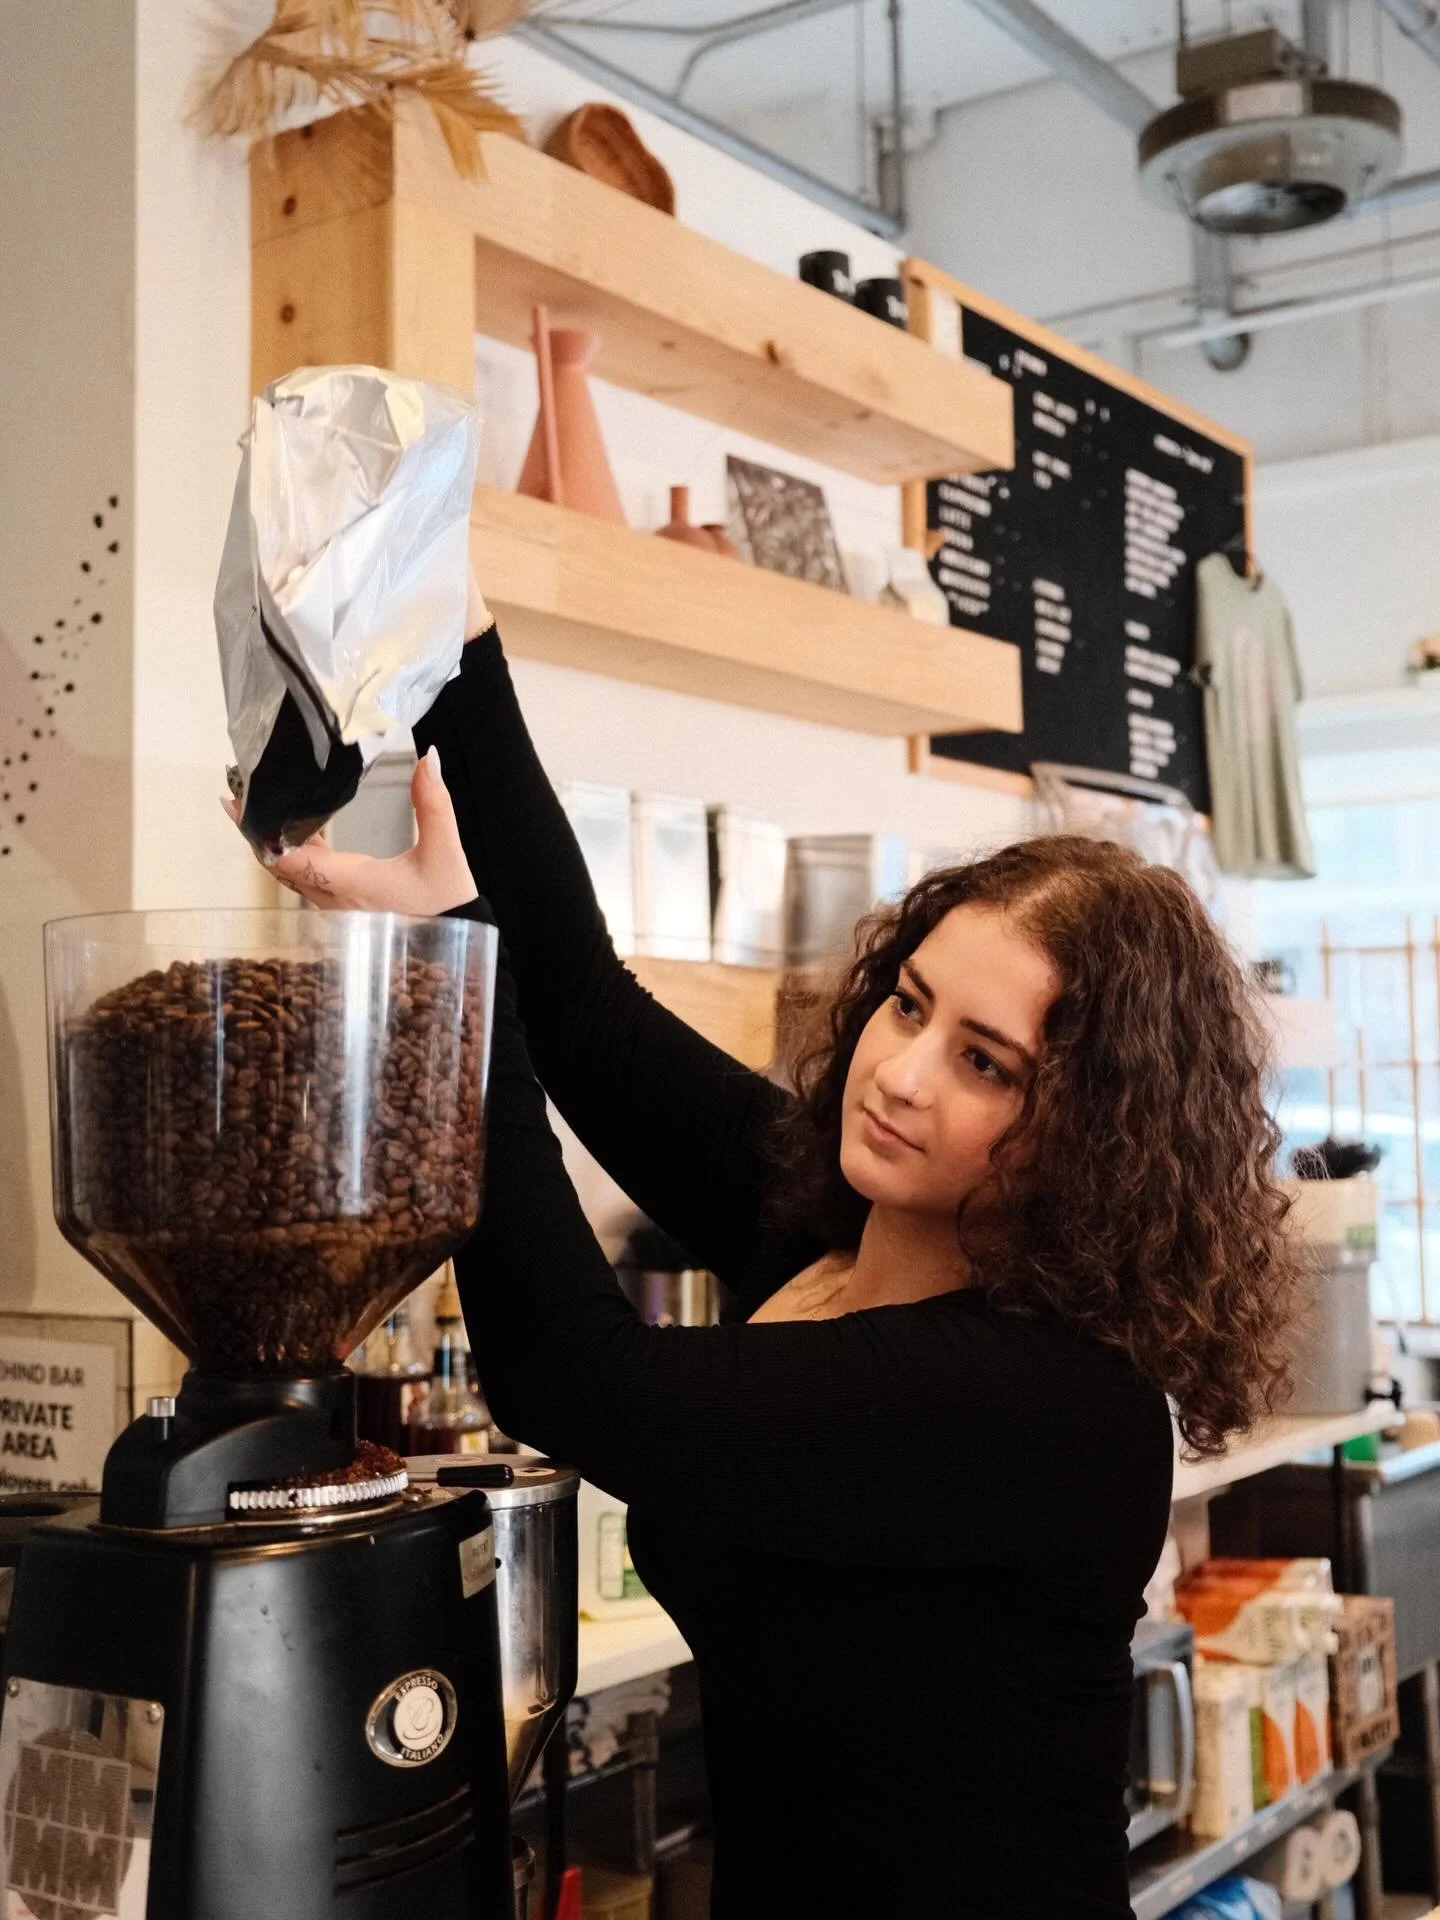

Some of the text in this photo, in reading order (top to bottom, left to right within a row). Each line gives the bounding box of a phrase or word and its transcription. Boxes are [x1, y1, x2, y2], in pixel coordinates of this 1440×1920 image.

[48, 1364, 84, 1387] BAR
[2, 1430, 57, 1460] AREA
[395, 1676, 438, 1701] ESPRESSO
[401, 1734, 444, 1760] ITALIANO
